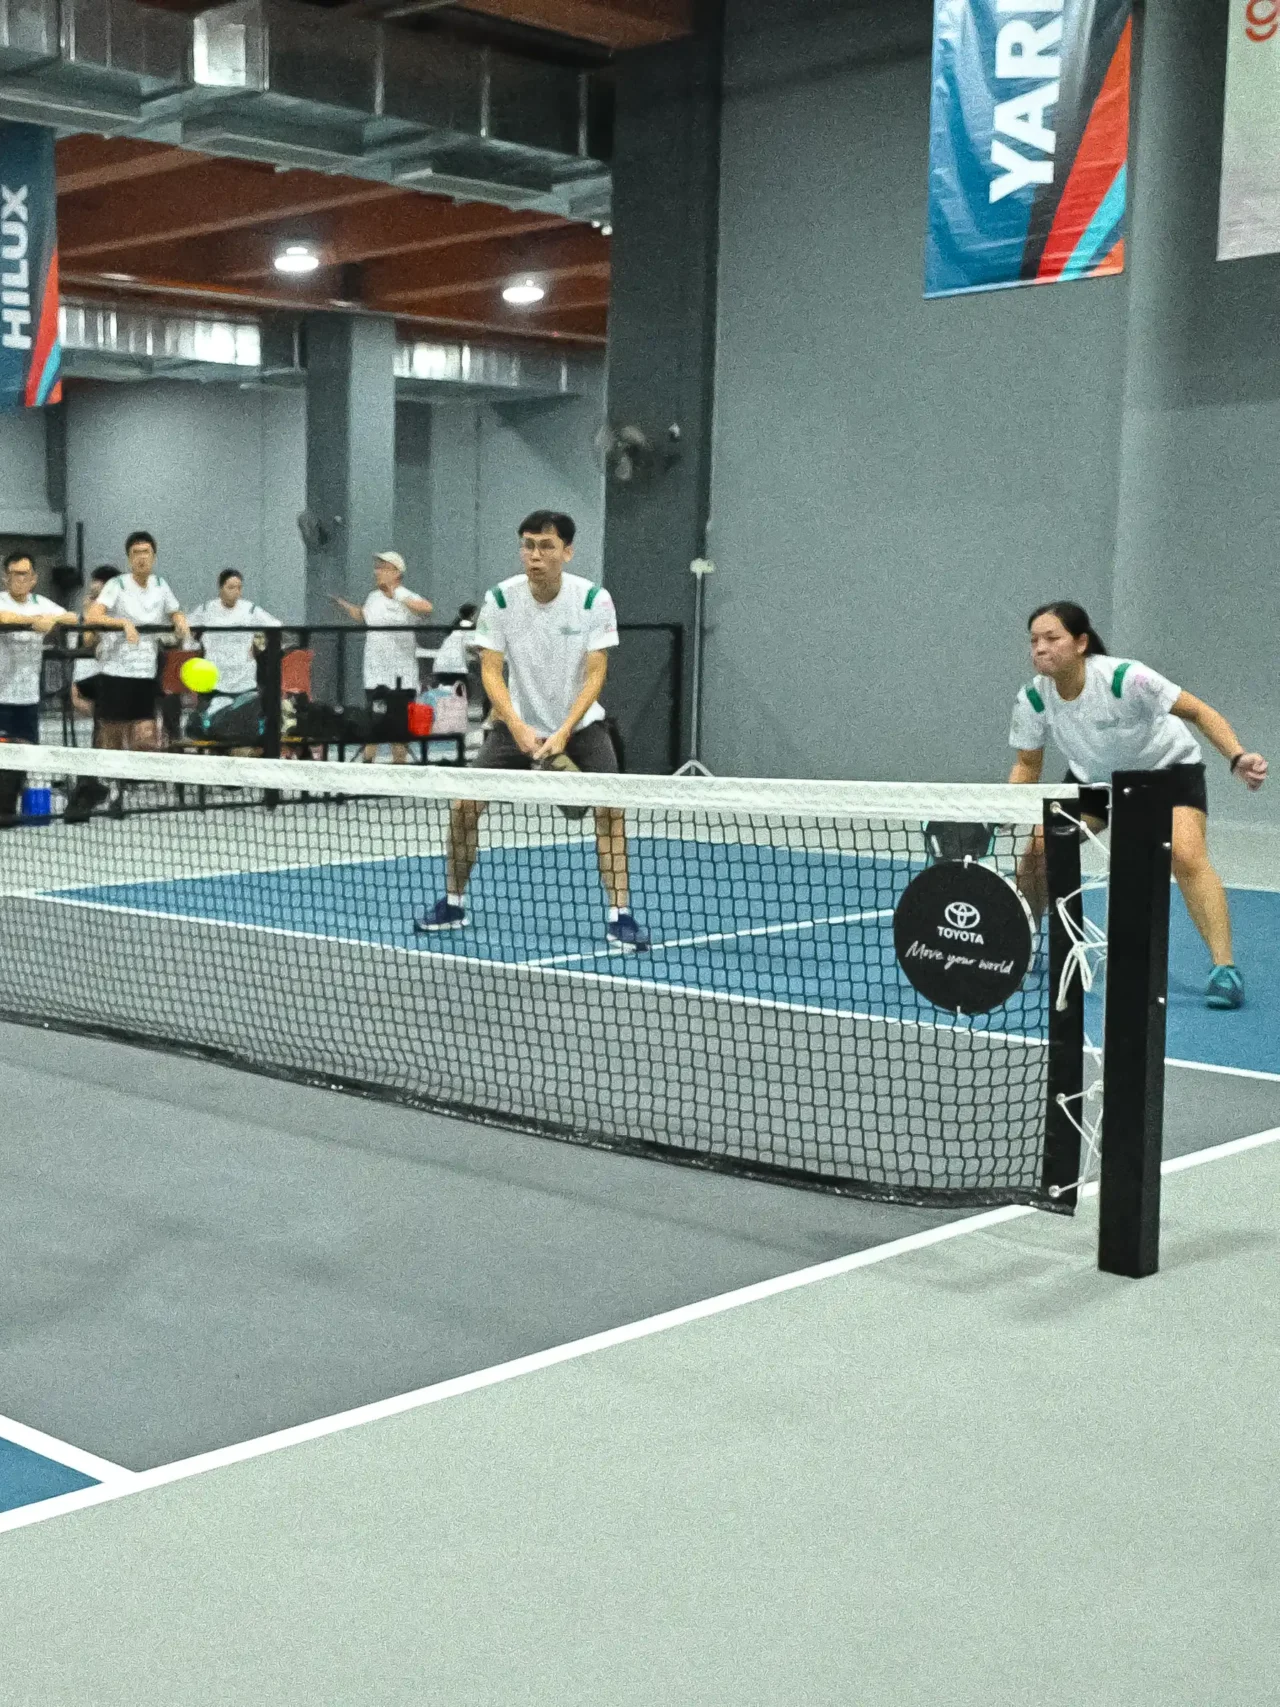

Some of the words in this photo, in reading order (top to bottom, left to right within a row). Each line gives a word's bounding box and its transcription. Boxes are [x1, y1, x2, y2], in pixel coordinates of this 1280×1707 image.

[1, 184, 32, 349] HILUX
[937, 925, 984, 945] TOYOTA
[905, 940, 943, 960] Move
[944, 954, 976, 970] your
[979, 960, 1014, 974] world
